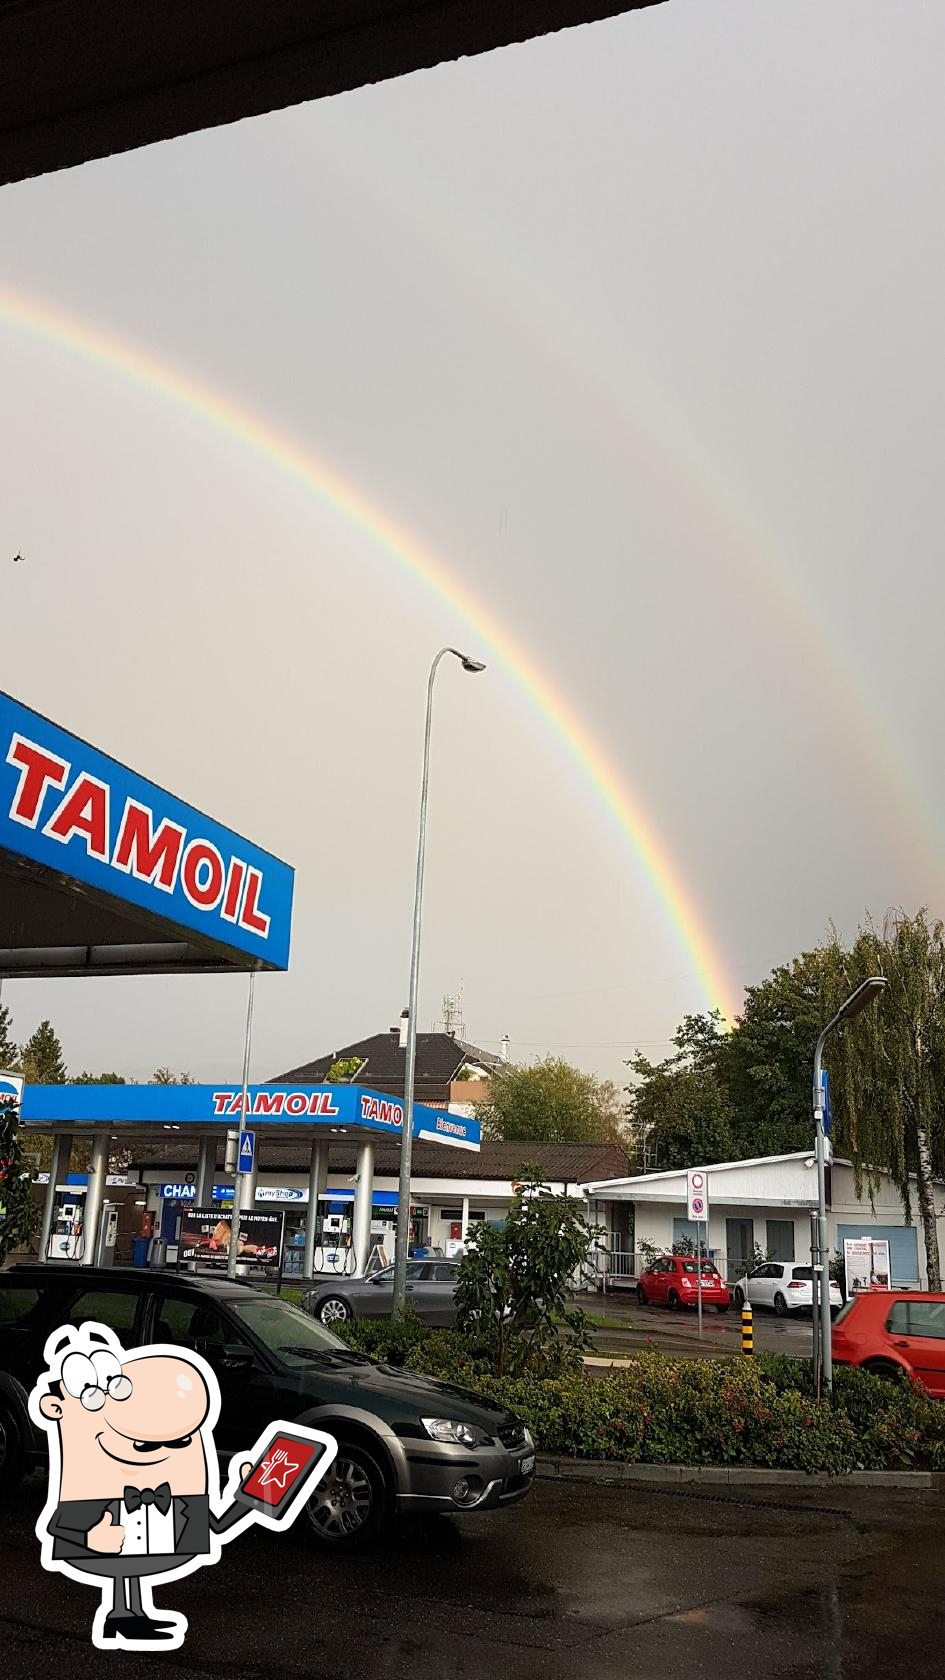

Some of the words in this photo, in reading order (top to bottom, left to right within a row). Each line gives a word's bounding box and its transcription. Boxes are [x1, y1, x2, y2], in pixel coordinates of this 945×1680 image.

[6, 732, 271, 939] TAMOIL
[212, 1092, 339, 1116] TAMOIL
[360, 1095, 413, 1129] TAMO
